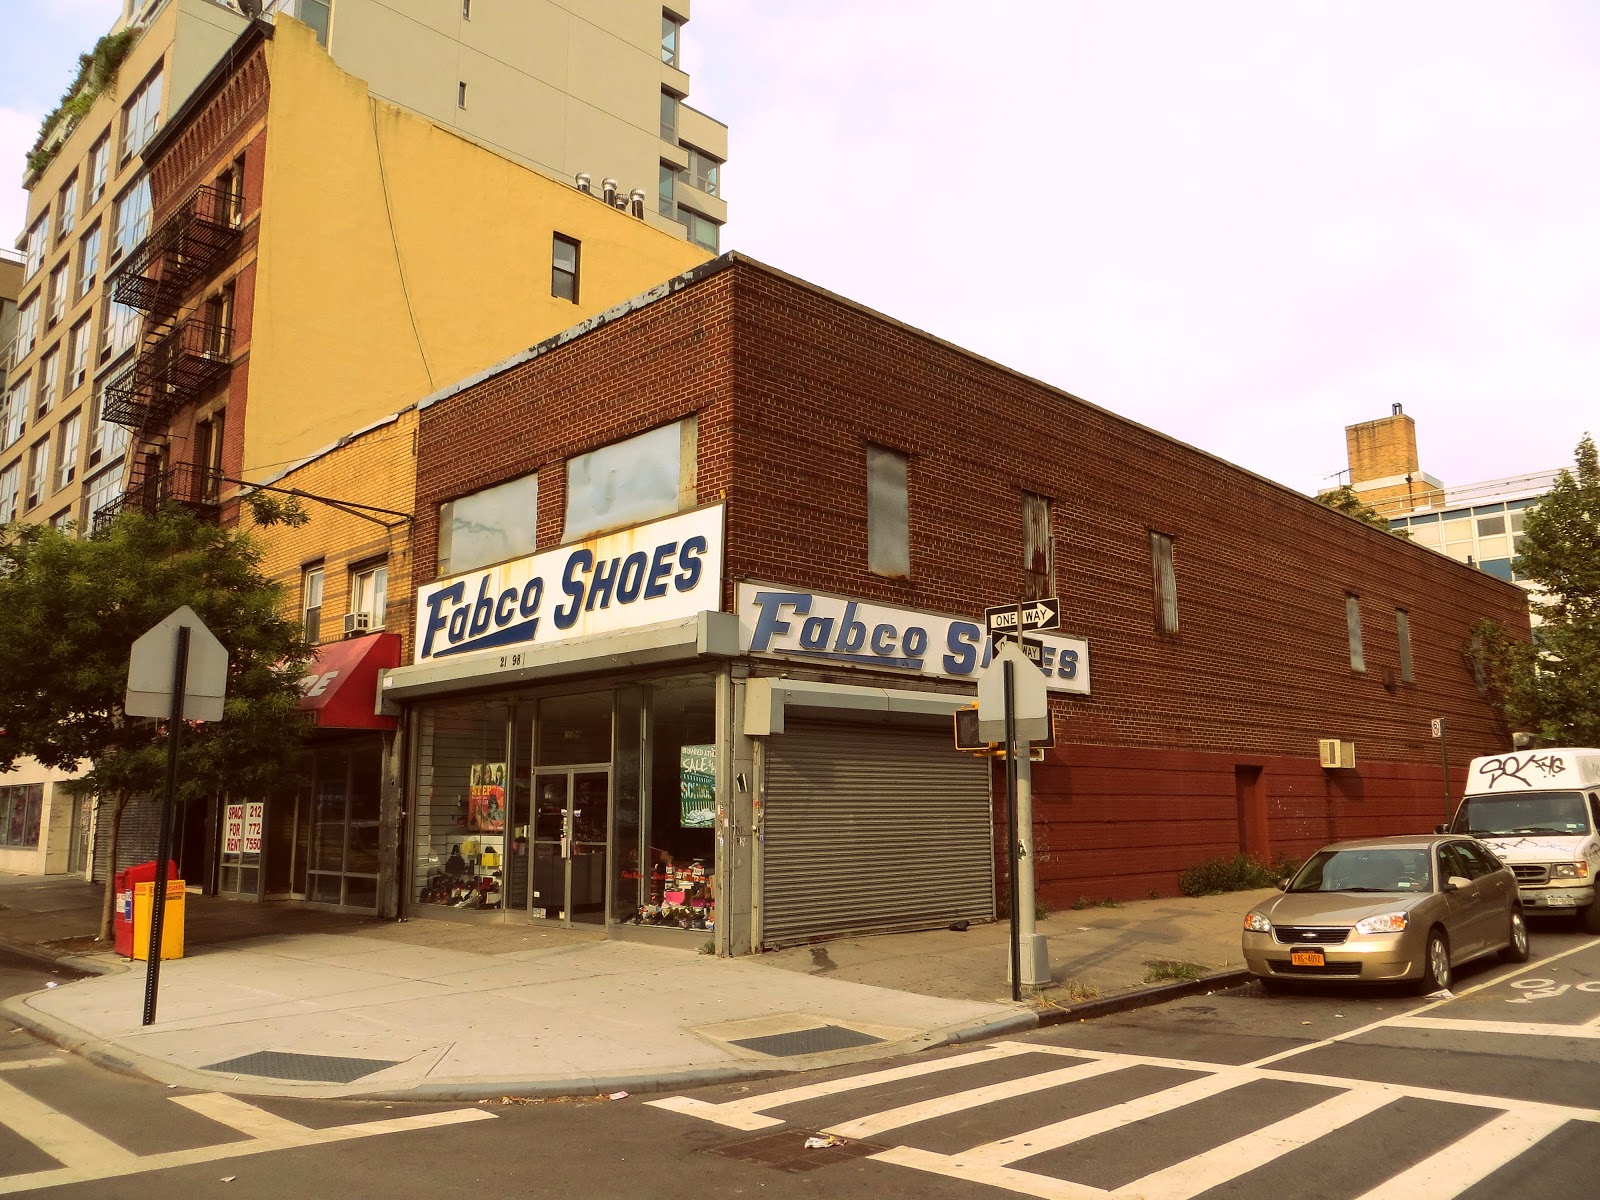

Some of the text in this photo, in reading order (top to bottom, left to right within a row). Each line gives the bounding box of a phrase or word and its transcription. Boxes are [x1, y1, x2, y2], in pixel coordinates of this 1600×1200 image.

[421, 535, 708, 659] Fabco SHOES
[996, 609, 1047, 626] ONE WAY
[749, 591, 1079, 680] Fabco SES
[683, 757, 708, 773] SALE
[472, 785, 491, 795] STEP
[249, 805, 262, 818] 212
[230, 823, 240, 836] FOR
[248, 822, 261, 835] 772
[227, 838, 241, 851] RENT
